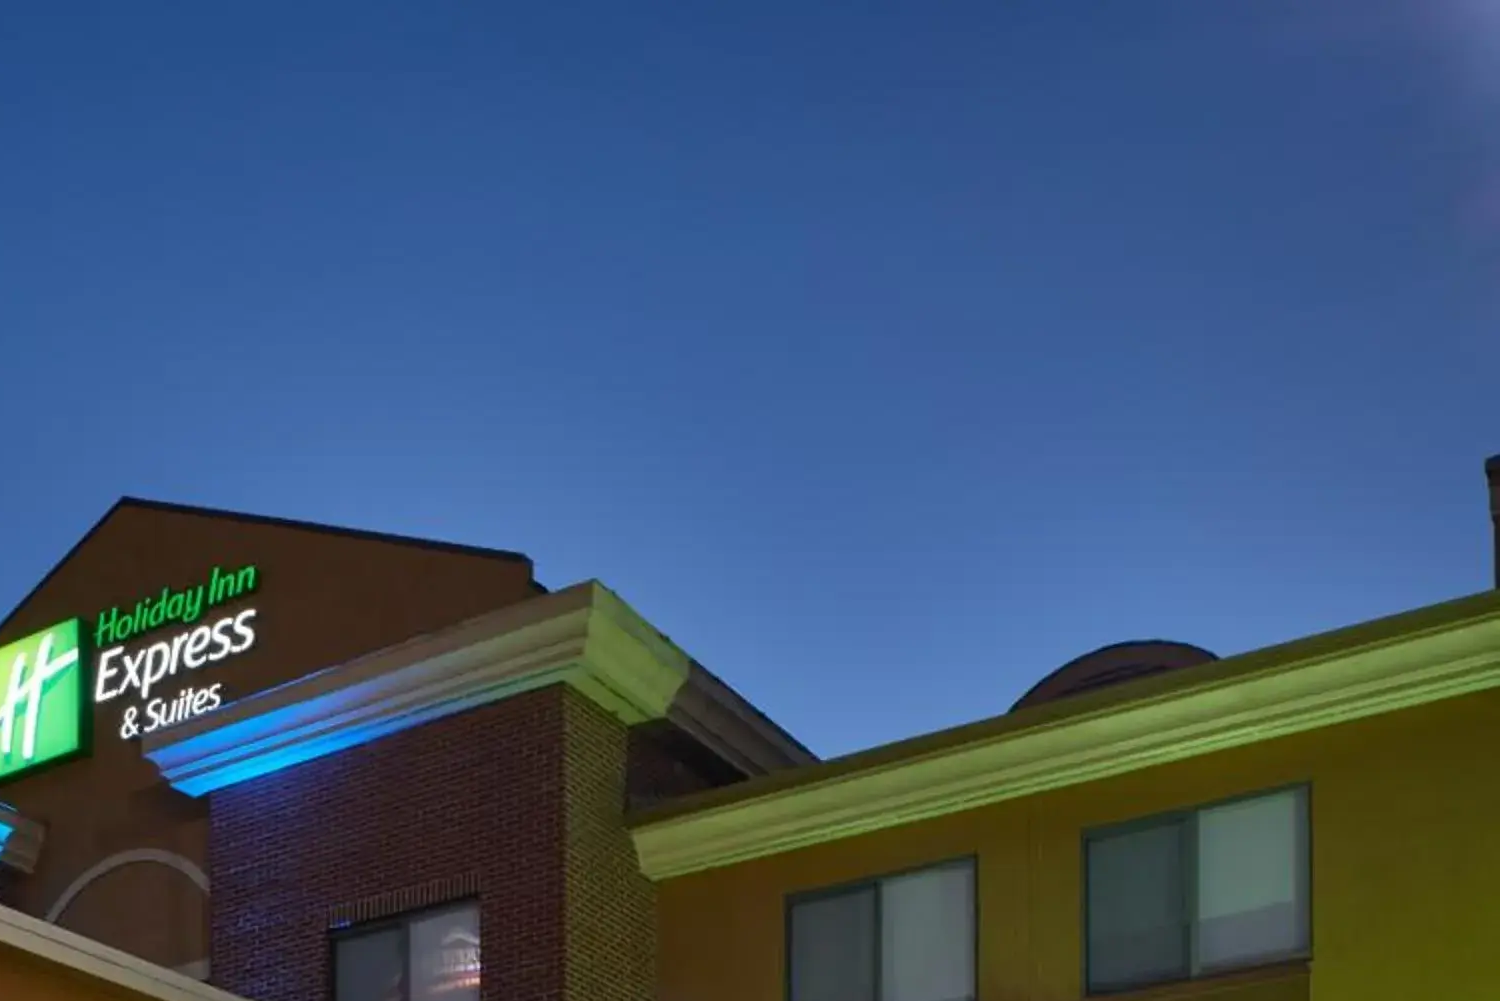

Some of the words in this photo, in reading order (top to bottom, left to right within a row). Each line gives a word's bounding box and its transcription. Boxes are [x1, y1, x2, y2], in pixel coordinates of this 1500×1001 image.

[94, 585, 202, 646] Holiday
[208, 565, 256, 604] Inn
[95, 609, 256, 702] Express
[120, 706, 139, 740] &
[144, 683, 221, 733] Suites
